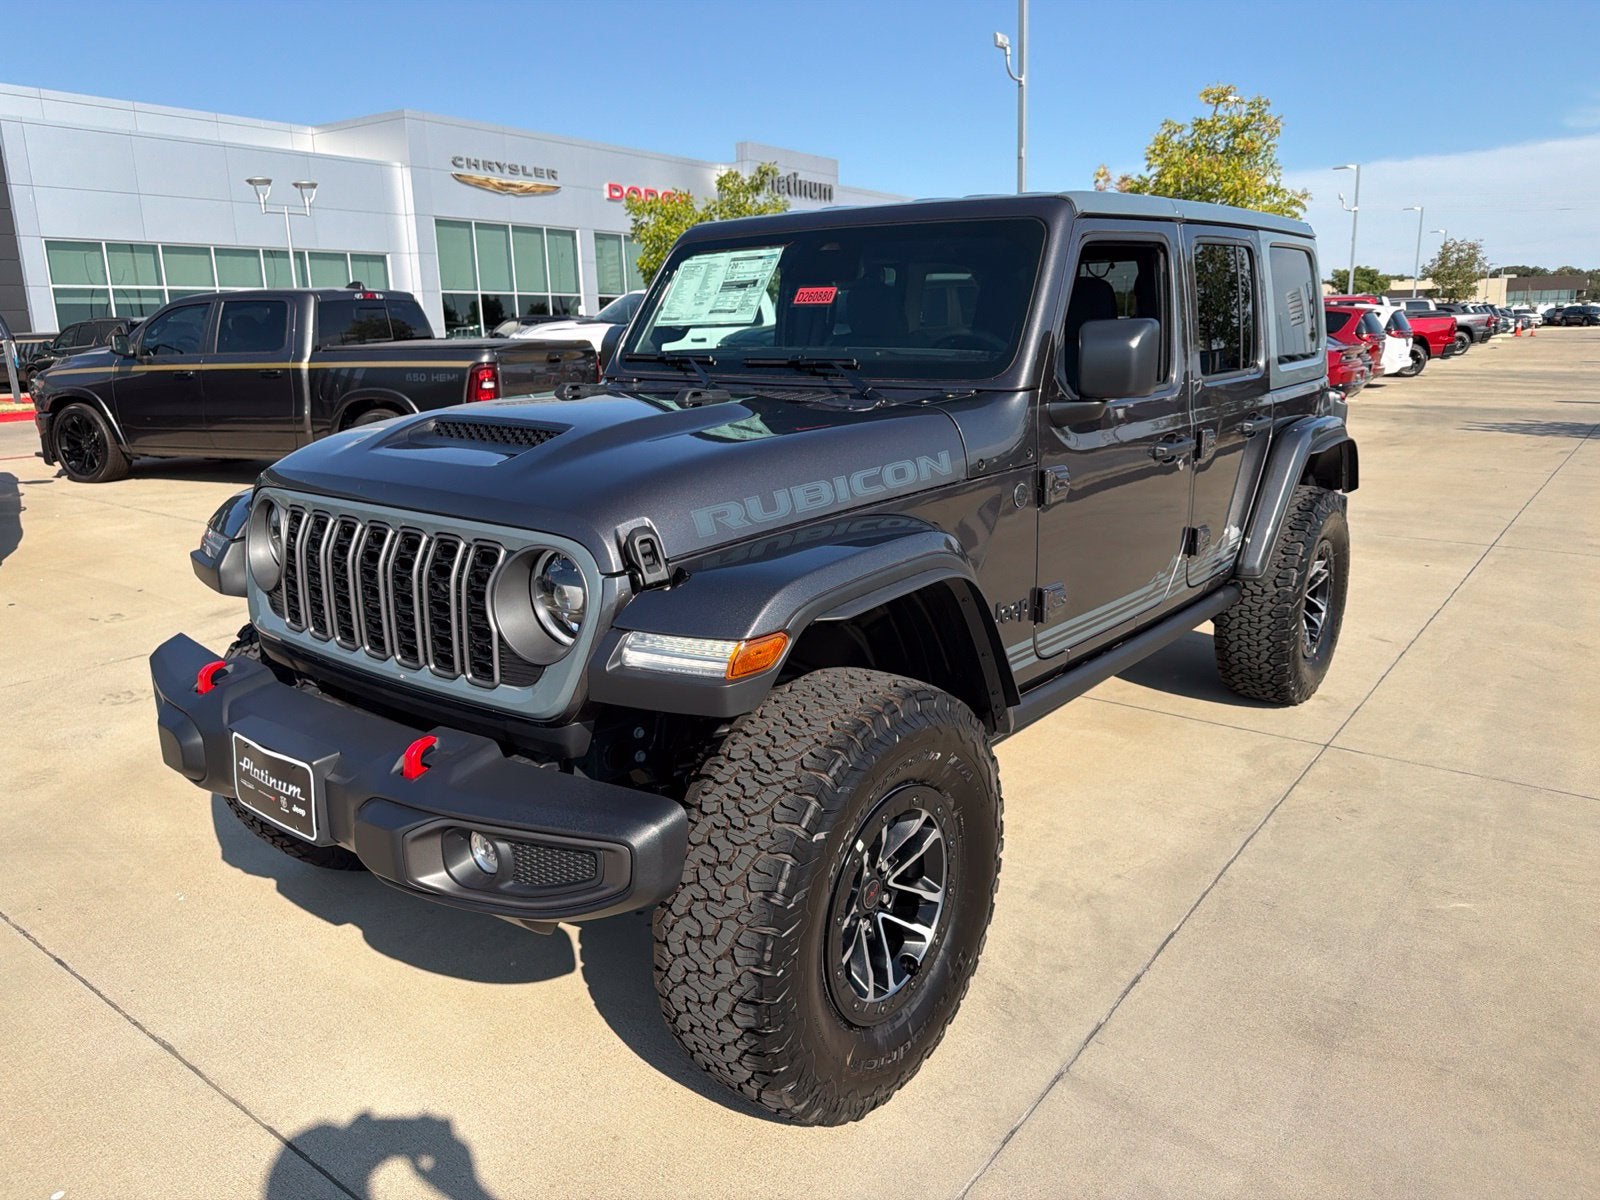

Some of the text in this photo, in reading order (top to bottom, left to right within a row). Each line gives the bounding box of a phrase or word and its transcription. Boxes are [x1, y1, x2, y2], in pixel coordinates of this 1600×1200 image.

[451, 156, 558, 180] CHRYSLER
[604, 183, 684, 204] DODG
[764, 172, 834, 202] latinum
[796, 290, 834, 303] D260880
[690, 450, 953, 538] RUBICON
[995, 599, 1028, 624] Jeep
[239, 757, 306, 801] Platinum
